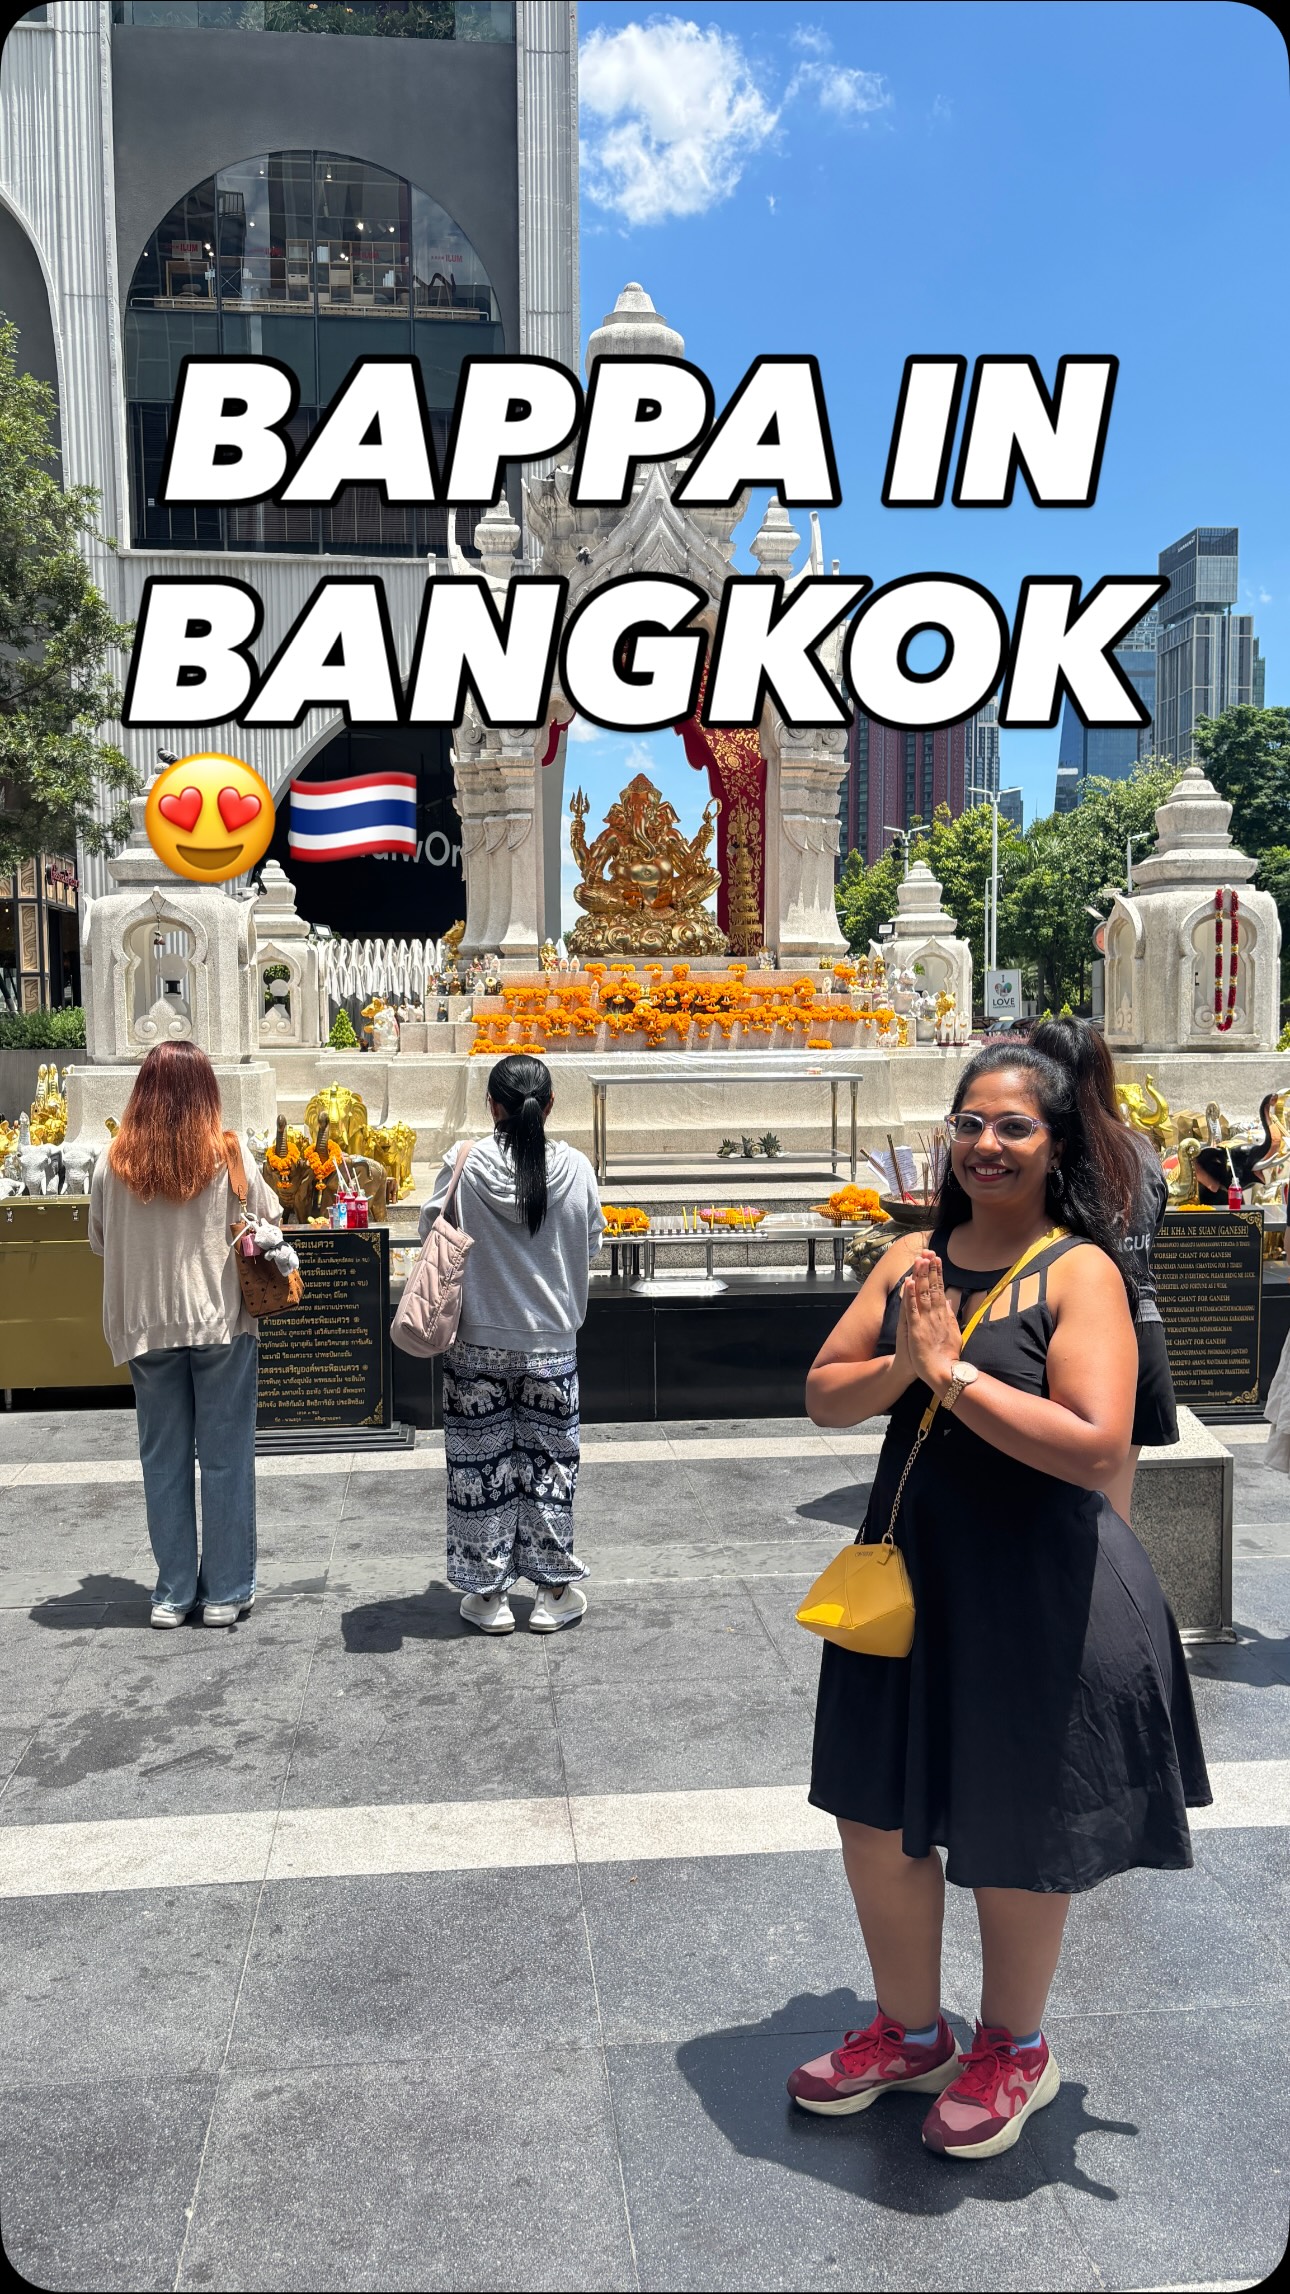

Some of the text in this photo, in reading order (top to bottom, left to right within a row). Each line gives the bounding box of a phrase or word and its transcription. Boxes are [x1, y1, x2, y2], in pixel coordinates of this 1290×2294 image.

[992, 997, 1015, 1006] LOVE
[1171, 1226, 1186, 1236] KHA
[1187, 1226, 1197, 1236] NE
[1198, 1225, 1216, 1235] SUAN
[1218, 1225, 1249, 1236] (GANESH)
